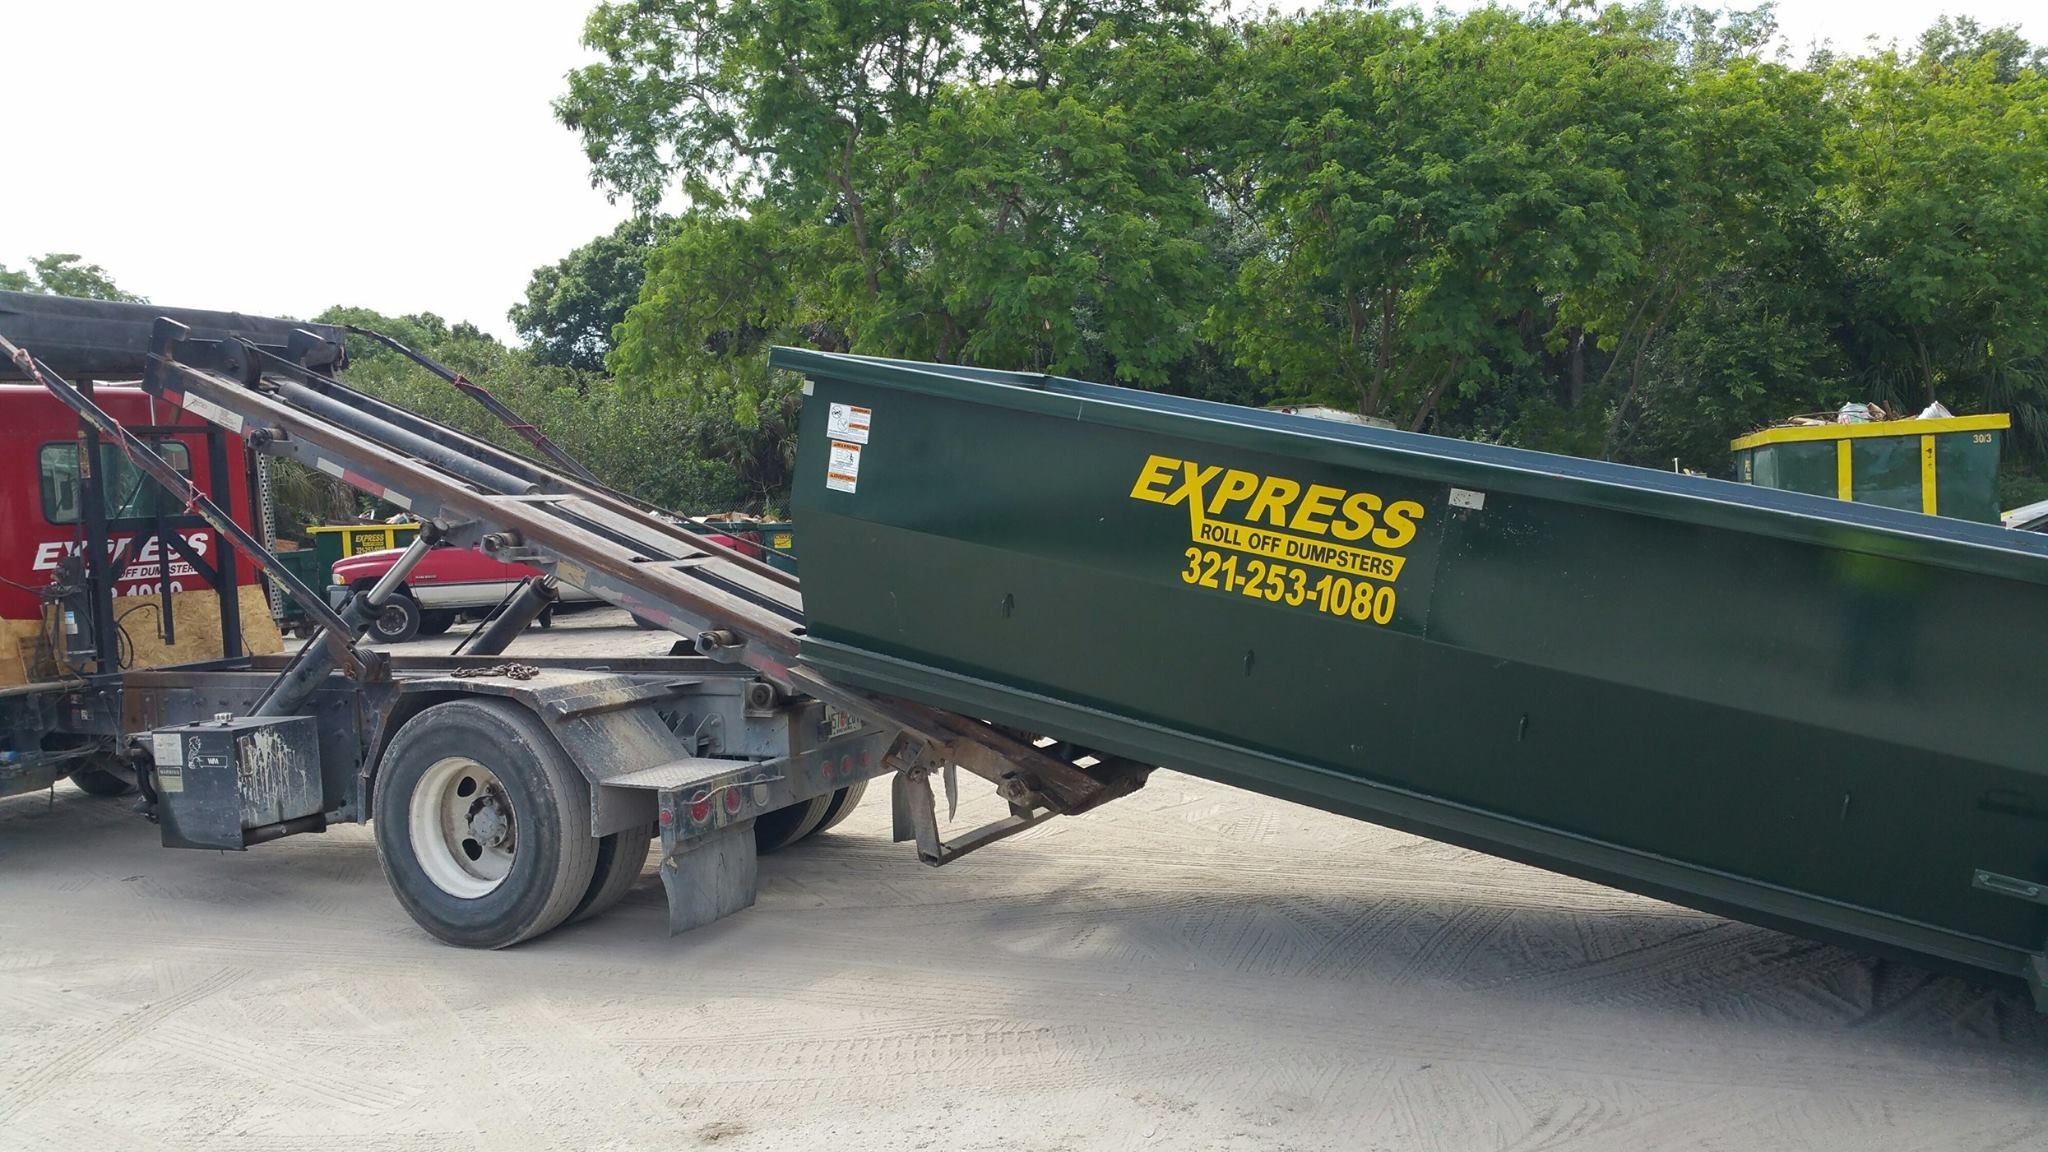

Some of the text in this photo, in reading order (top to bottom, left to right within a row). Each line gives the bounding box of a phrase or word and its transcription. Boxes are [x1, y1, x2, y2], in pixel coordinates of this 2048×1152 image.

[1130, 454, 1425, 549] EXPRESS
[32, 532, 208, 572] EESS
[355, 534, 384, 543] EXPRESS
[1200, 523, 1394, 576] ROLL OFF DUMPSTERS
[140, 564, 195, 577] DUMSTER
[1181, 547, 1396, 625] 321-253-1080
